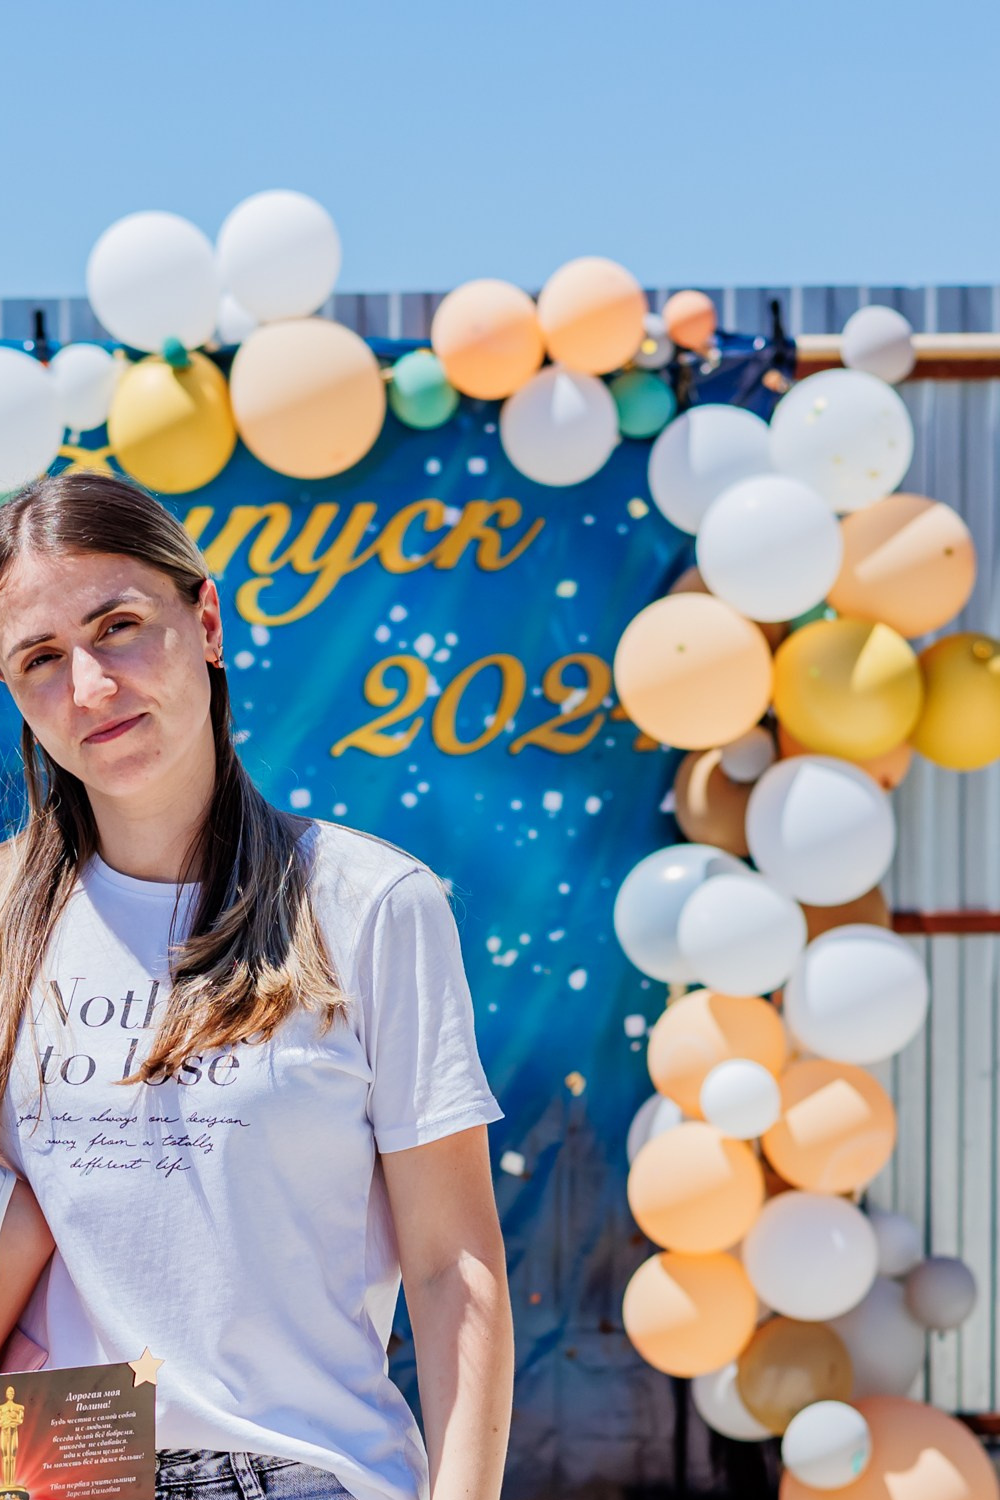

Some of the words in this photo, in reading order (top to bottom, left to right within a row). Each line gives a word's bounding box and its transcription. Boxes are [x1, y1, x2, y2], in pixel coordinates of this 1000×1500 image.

[182, 498, 546, 627] пуск
[330, 652, 655, 757] 202
[39, 1045, 97, 1086] to
[16, 1111, 43, 1127] you
[51, 1112, 82, 1122] are
[89, 1109, 138, 1129] always
[148, 1115, 179, 1123] one
[185, 1111, 251, 1127] decision
[44, 1138, 77, 1151] away
[89, 1133, 137, 1152] from
[142, 1139, 153, 1147] a
[161, 1135, 214, 1152] totally
[69, 1157, 151, 1176] different
[155, 1157, 192, 1178] life
[65, 1391, 102, 1403] Дорогая
[103, 1389, 121, 1398] моя
[75, 1400, 112, 1412] Полина!
[50, 1418, 66, 1427] Будь
[66, 1417, 92, 1425] честна
[97, 1413, 117, 1421] самой
[118, 1411, 137, 1420] собой
[74, 1433, 93, 1441] делай
[42, 1462, 52, 1470] Ты
[53, 1461, 82, 1469] можешь
[99, 1456, 117, 1464] даже
[118, 1452, 145, 1461] больше!
[82, 1449, 101, 1457] своим
[50, 1483, 66, 1491] Твоя
[66, 1480, 90, 1490] первая
[90, 1476, 137, 1488] учительница
[91, 1486, 121, 1496] Кимовна
